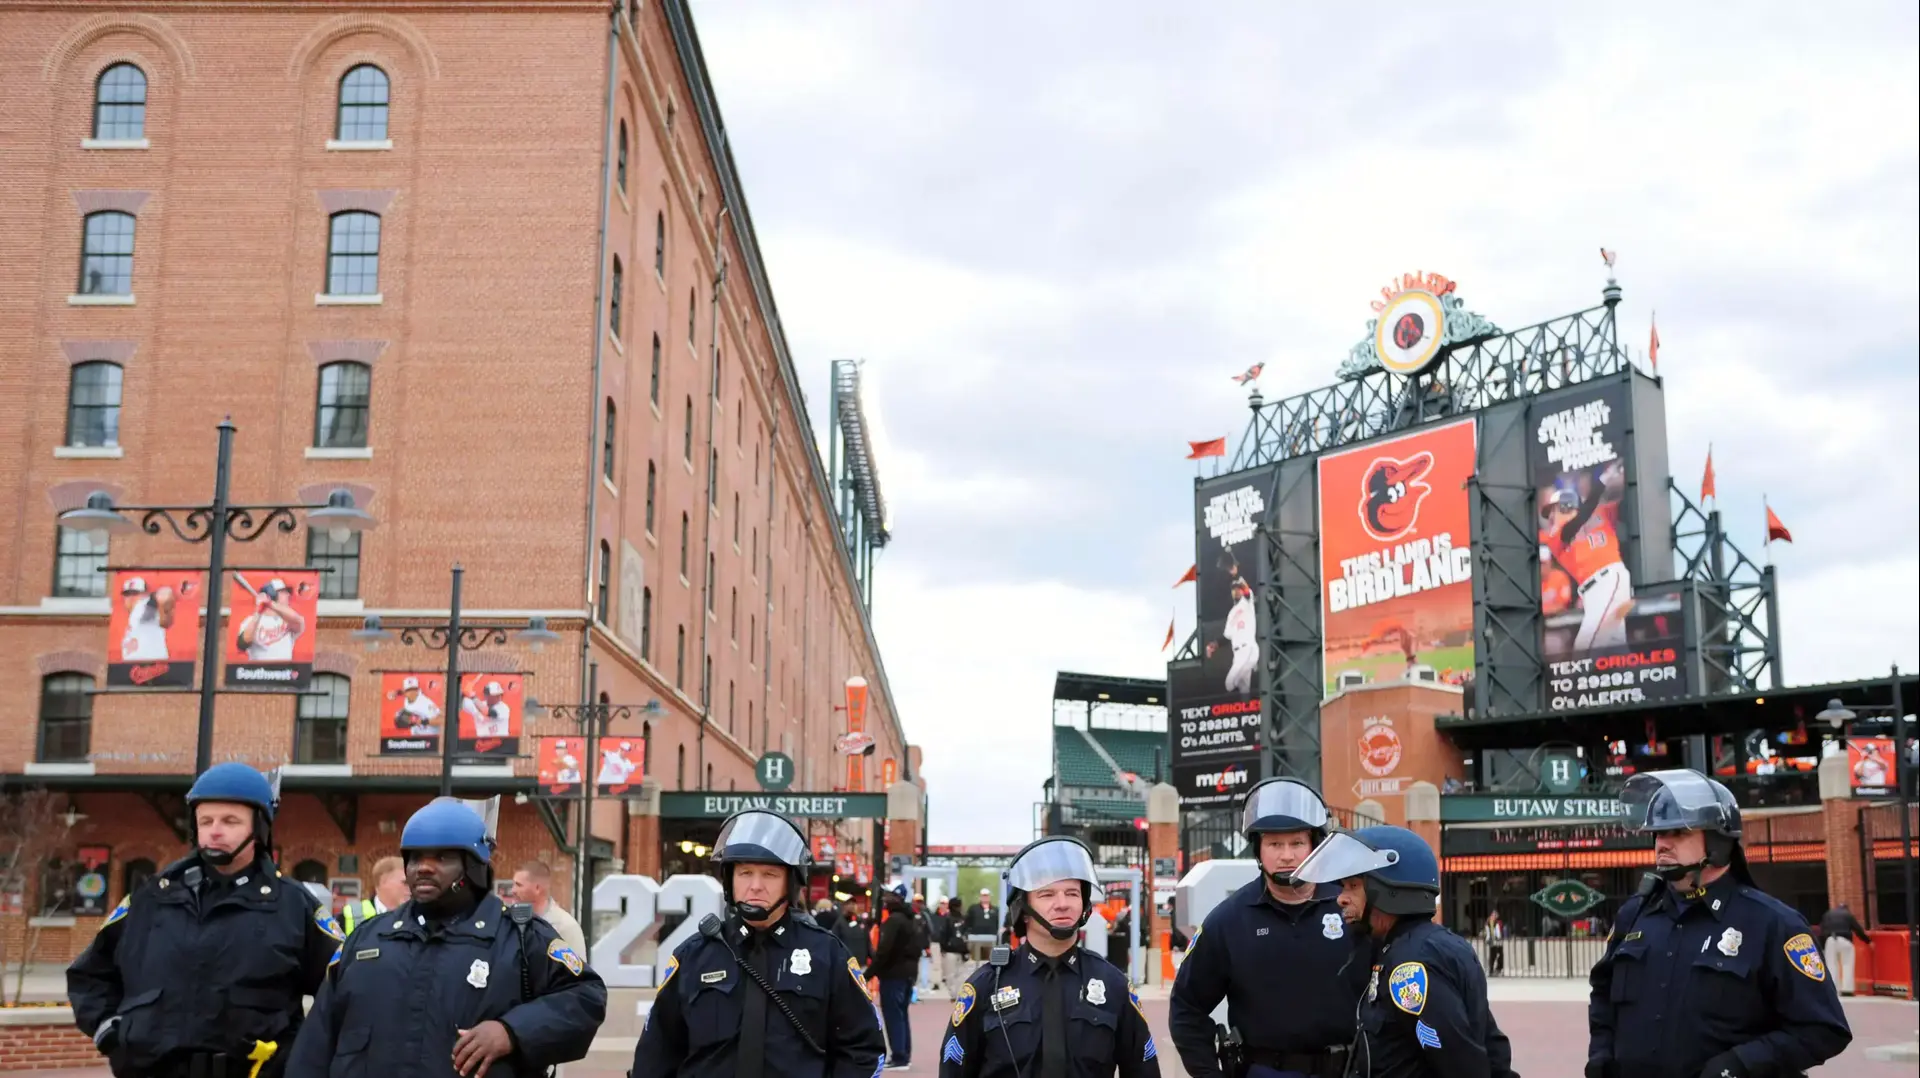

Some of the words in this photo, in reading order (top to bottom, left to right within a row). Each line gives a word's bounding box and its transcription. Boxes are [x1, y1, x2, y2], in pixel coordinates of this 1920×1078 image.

[1340, 551, 1382, 578] THIS
[1382, 538, 1432, 567] LAND
[1432, 532, 1453, 555] IS
[1328, 547, 1473, 613] BIRDLAND
[1549, 658, 1592, 676] TEXT
[1595, 648, 1676, 670] ORIOLES
[236, 667, 292, 680] Southwest
[1550, 678, 1573, 692] TO
[1577, 671, 1634, 690] 29292
[1640, 666, 1676, 683] FOR
[1552, 696, 1576, 710] O's
[1181, 706, 1210, 719] TEXT
[1181, 722, 1196, 733] TO
[387, 739, 426, 749] Southwest
[765, 758, 785, 779] H
[1551, 760, 1570, 780] H
[704, 797, 771, 814] EUTAW
[775, 797, 847, 814] STREET
[1494, 798, 1559, 816] EUTAW
[1563, 798, 1634, 816] STREET
[590, 874, 724, 988] 22
[1256, 928, 1269, 936] ESU
